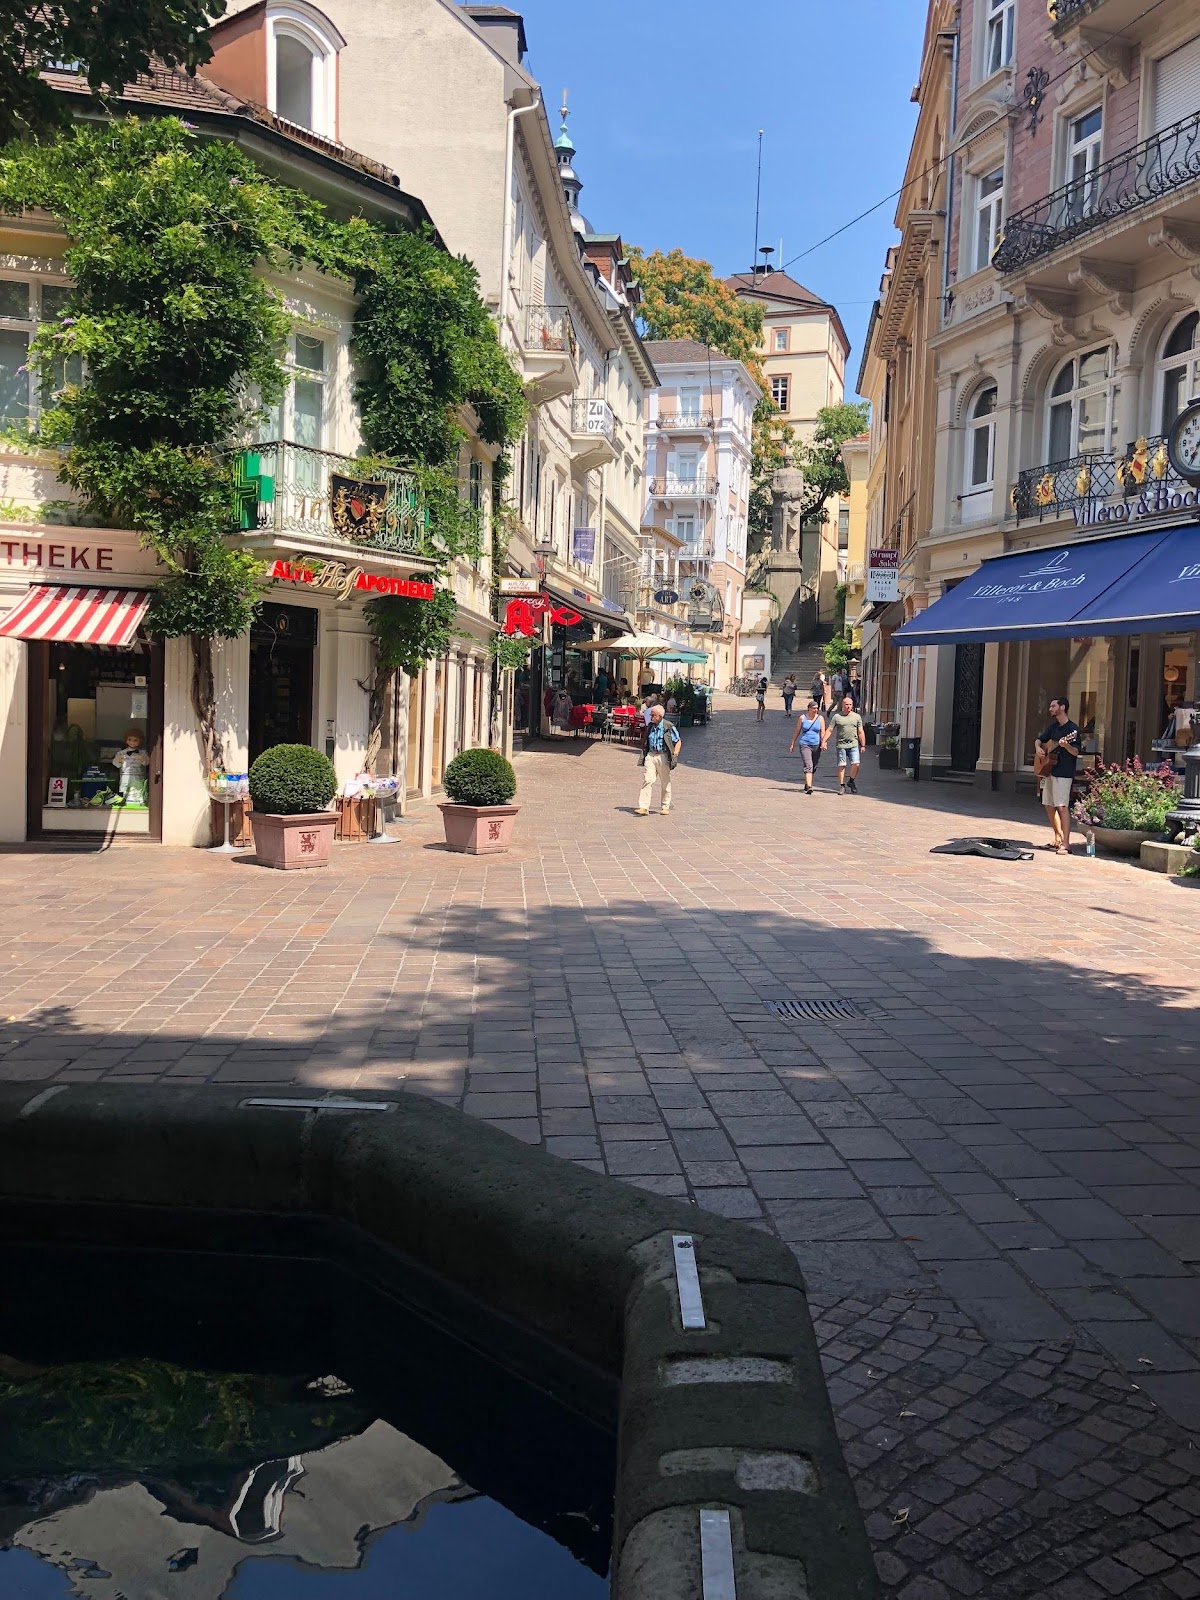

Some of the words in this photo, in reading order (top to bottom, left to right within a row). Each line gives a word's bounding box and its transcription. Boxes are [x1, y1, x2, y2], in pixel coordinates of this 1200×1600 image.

[589, 401, 603, 416] Zu
[1182, 439, 1187, 447] 9
[1073, 501, 1136, 527] Villeroy
[1137, 491, 1154, 515] &
[1, 541, 114, 571] THEKE
[870, 550, 899, 560] Strumpf
[303, 555, 364, 601] Hof
[355, 572, 434, 600] APOTHEKE
[973, 583, 1029, 597] Villeroy
[1029, 581, 1043, 591] &
[1042, 573, 1086, 590] Boch
